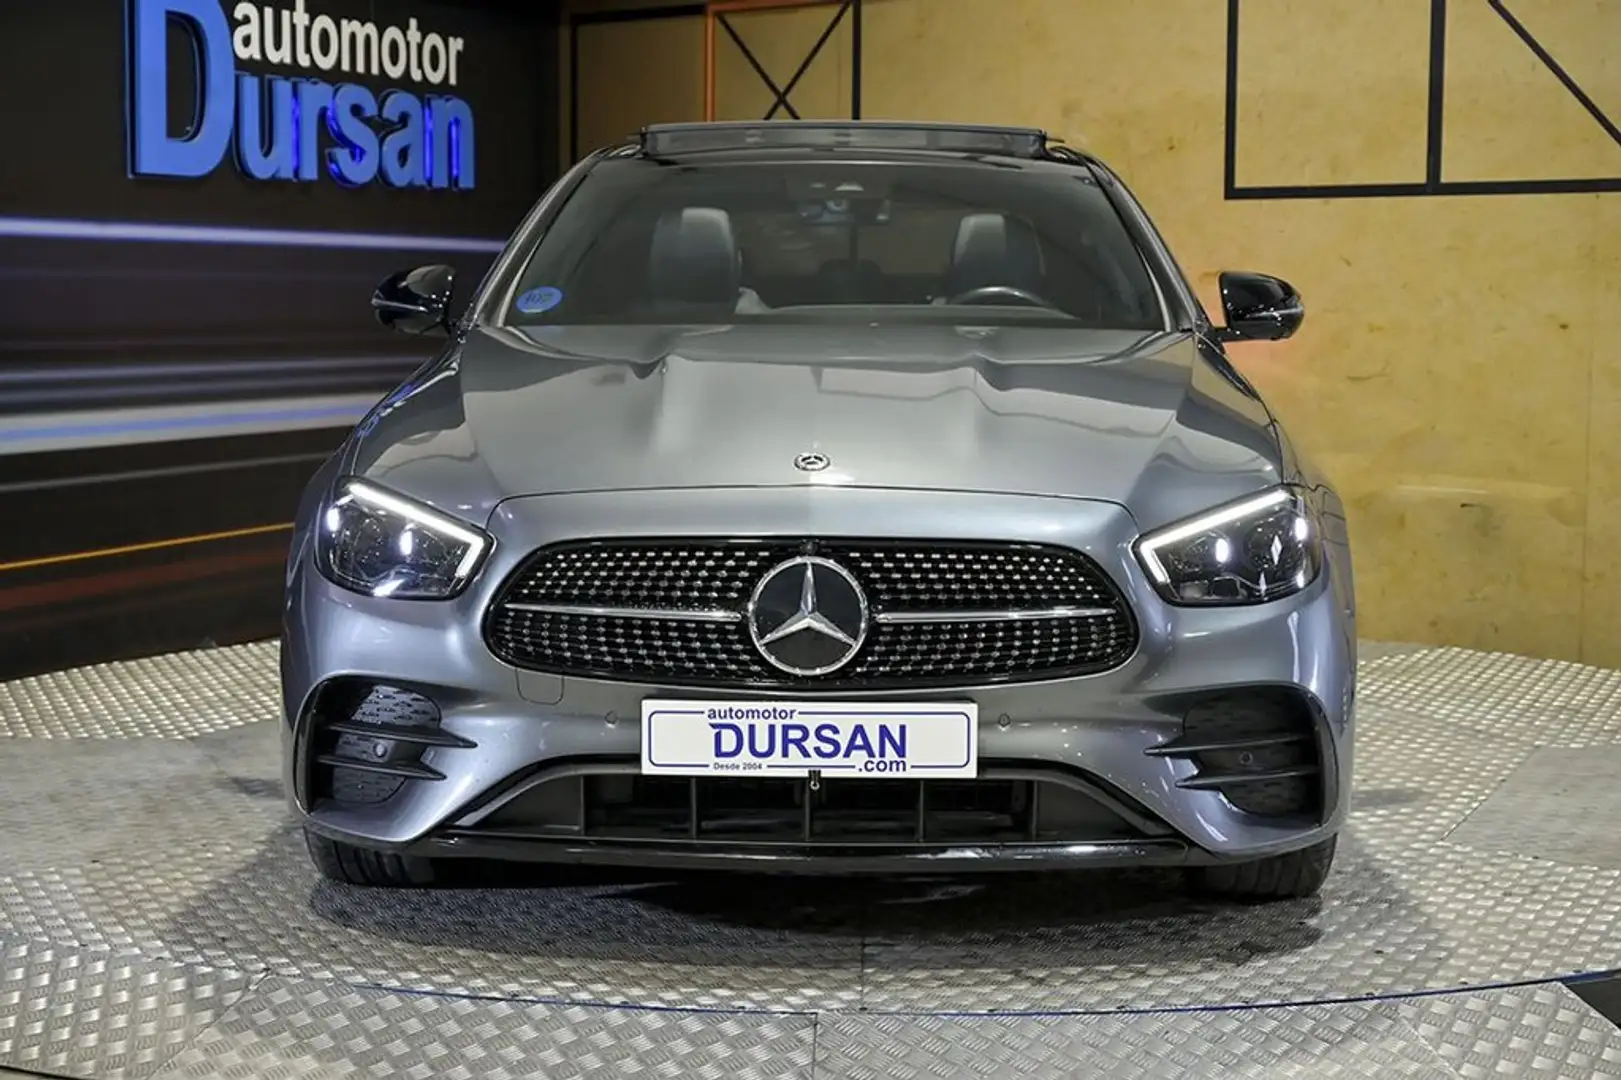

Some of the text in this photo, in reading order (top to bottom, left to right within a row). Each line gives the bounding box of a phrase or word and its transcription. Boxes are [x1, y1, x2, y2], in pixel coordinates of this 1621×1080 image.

[233, 0, 464, 85] automotor
[126, 0, 476, 190] Dursan
[707, 707, 796, 721] automotor
[709, 723, 907, 759] DURSAN
[713, 762, 763, 770] Desde 2004
[858, 758, 907, 772] .com
